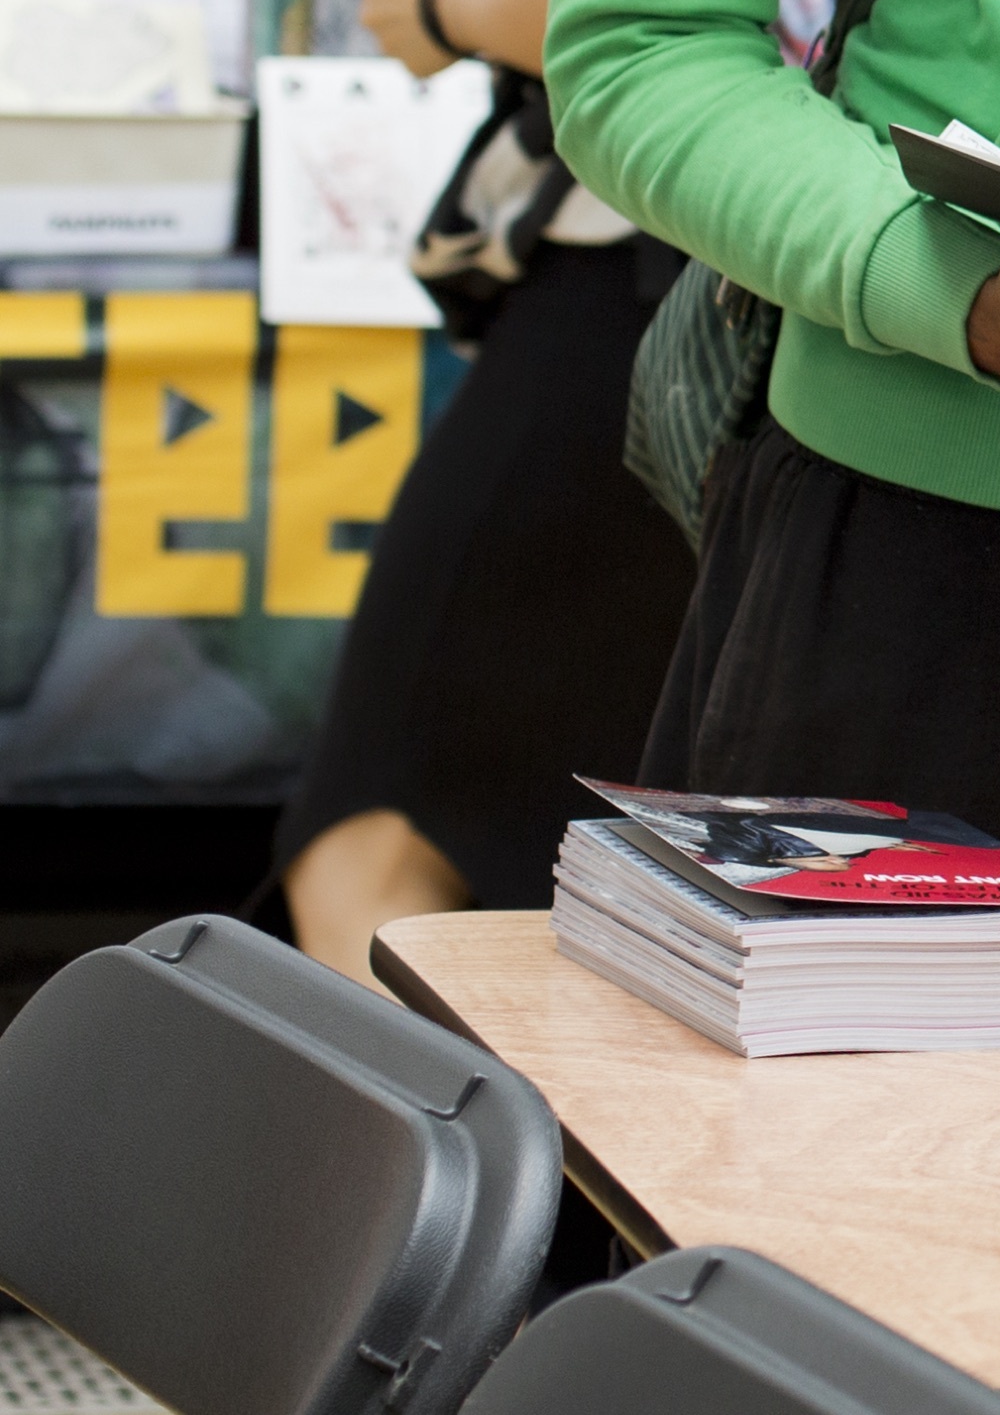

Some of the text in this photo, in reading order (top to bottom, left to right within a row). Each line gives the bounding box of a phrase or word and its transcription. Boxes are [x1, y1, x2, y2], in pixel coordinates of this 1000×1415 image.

[863, 873, 947, 884] ROW
[819, 880, 884, 890] THE
[890, 882, 936, 892] OF
